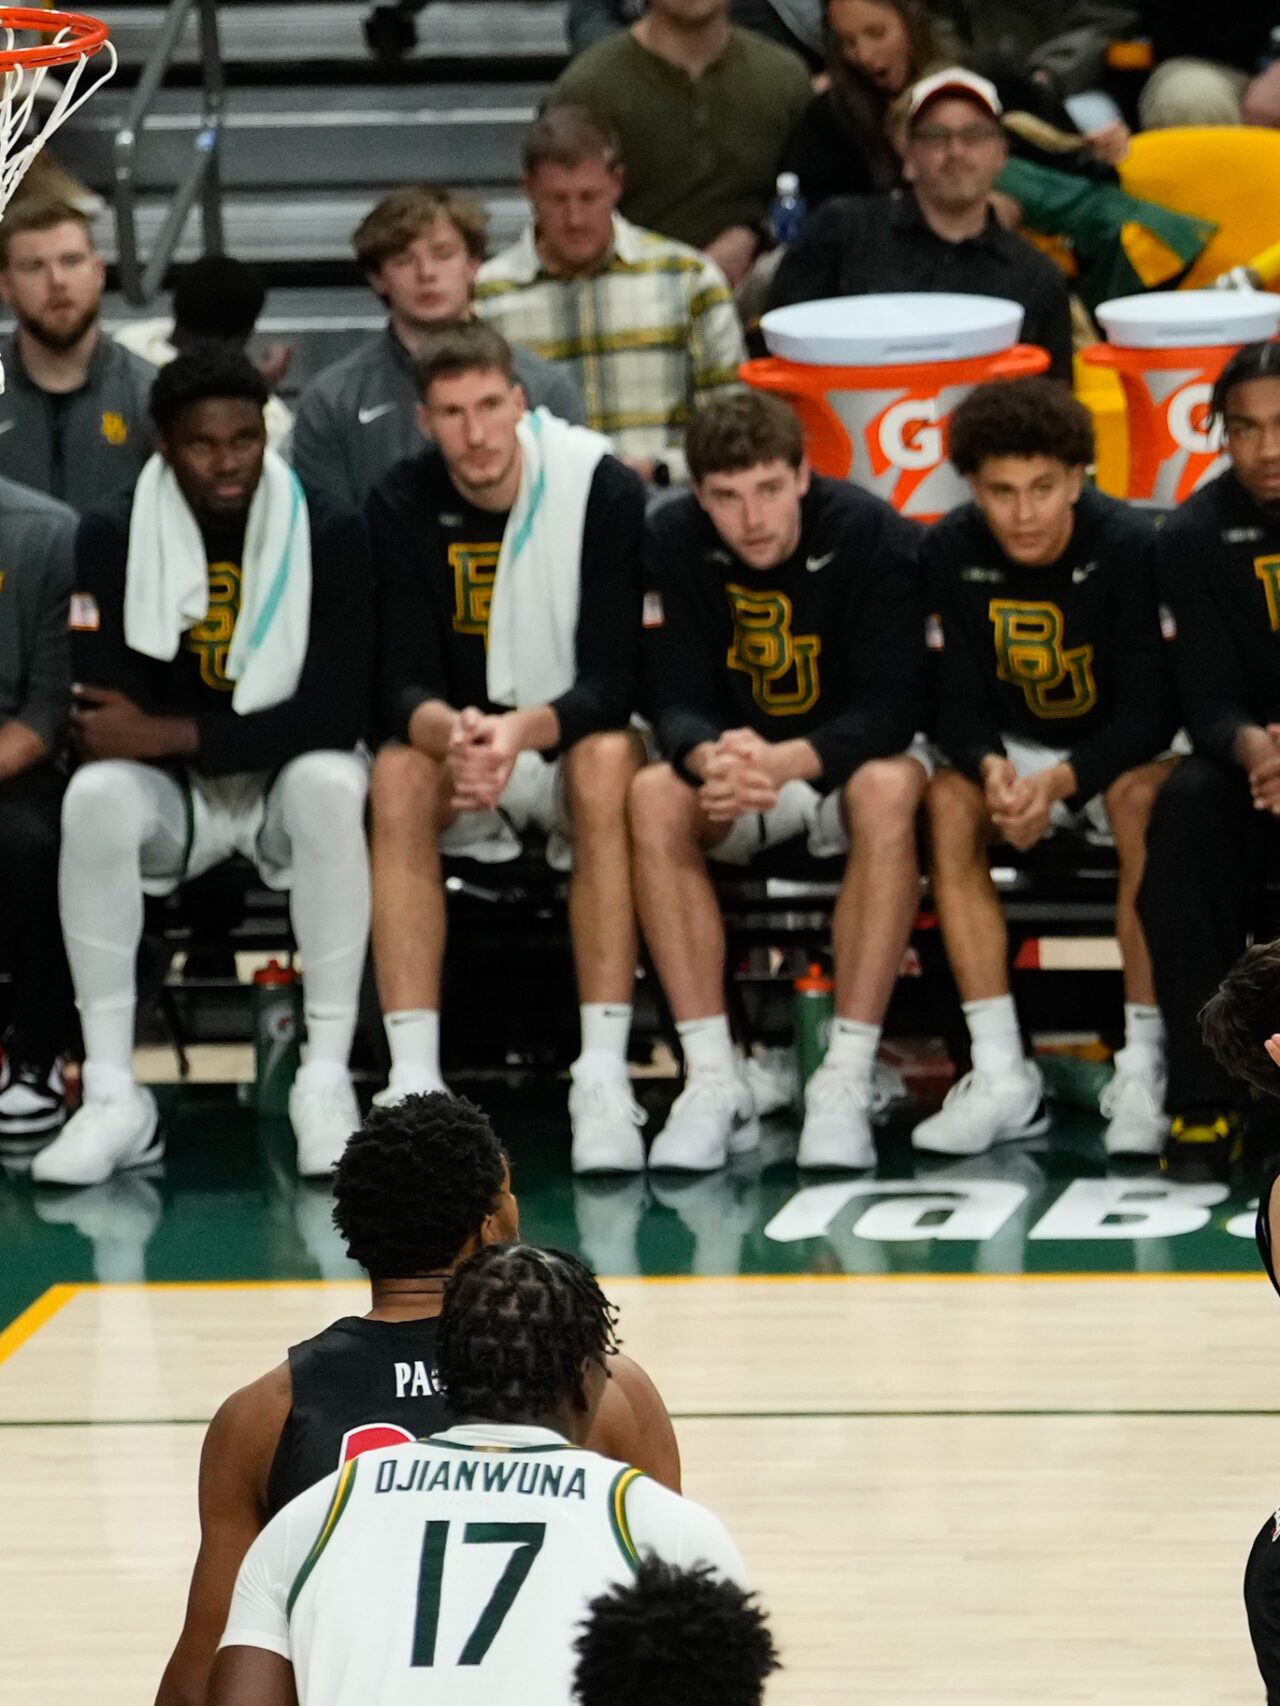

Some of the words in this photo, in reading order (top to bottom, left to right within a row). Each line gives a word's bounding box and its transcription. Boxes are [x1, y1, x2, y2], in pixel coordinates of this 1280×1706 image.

[878, 399, 943, 471] G
[725, 582, 822, 717] BU
[988, 597, 1098, 719] BU
[374, 1459, 586, 1500] OJIANWUNA
[409, 1519, 548, 1668] 17
